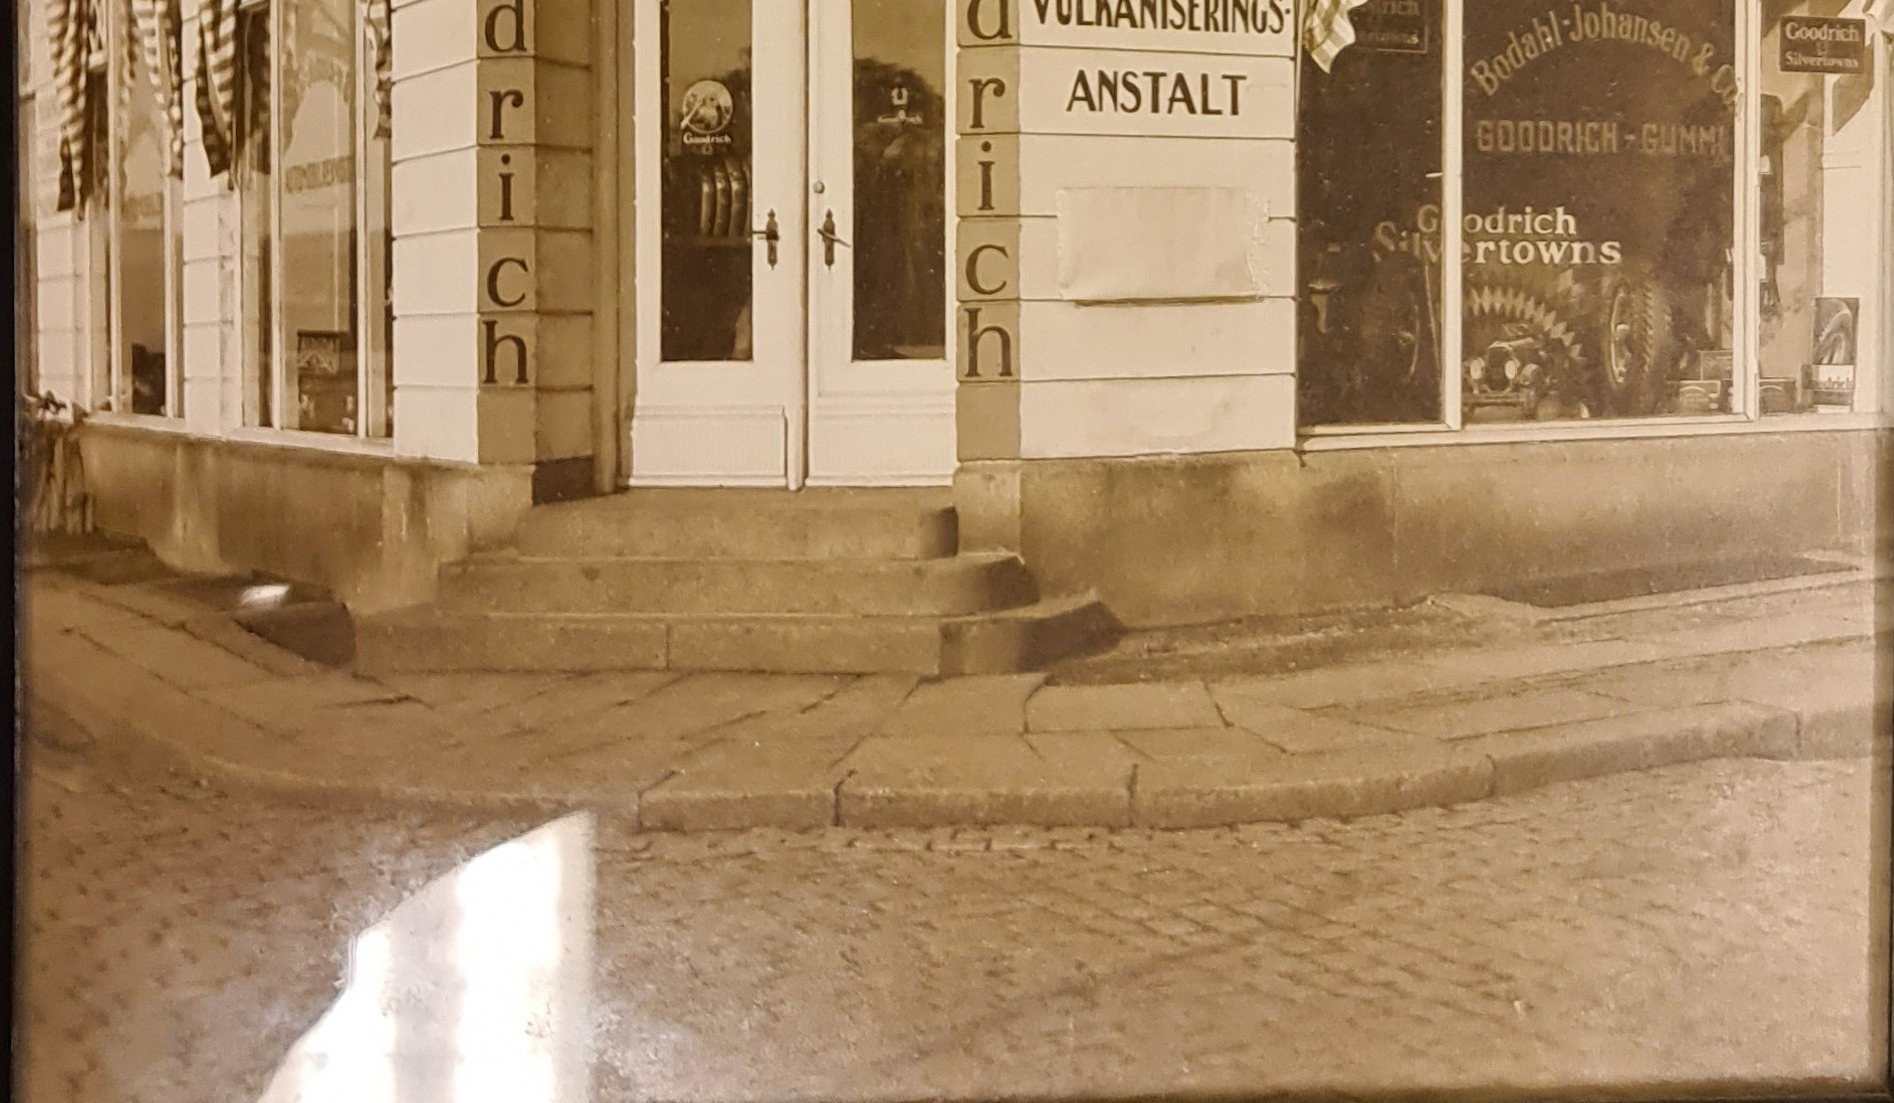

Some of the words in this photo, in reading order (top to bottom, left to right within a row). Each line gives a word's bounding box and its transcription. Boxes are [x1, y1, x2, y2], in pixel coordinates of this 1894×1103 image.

[1784, 21, 1860, 43] Goodrich
[1691, 42, 1715, 77] &
[1784, 49, 1859, 68] Silvertowns
[1065, 69, 1248, 116] ANSTALT
[1416, 203, 1577, 235] Godrich
